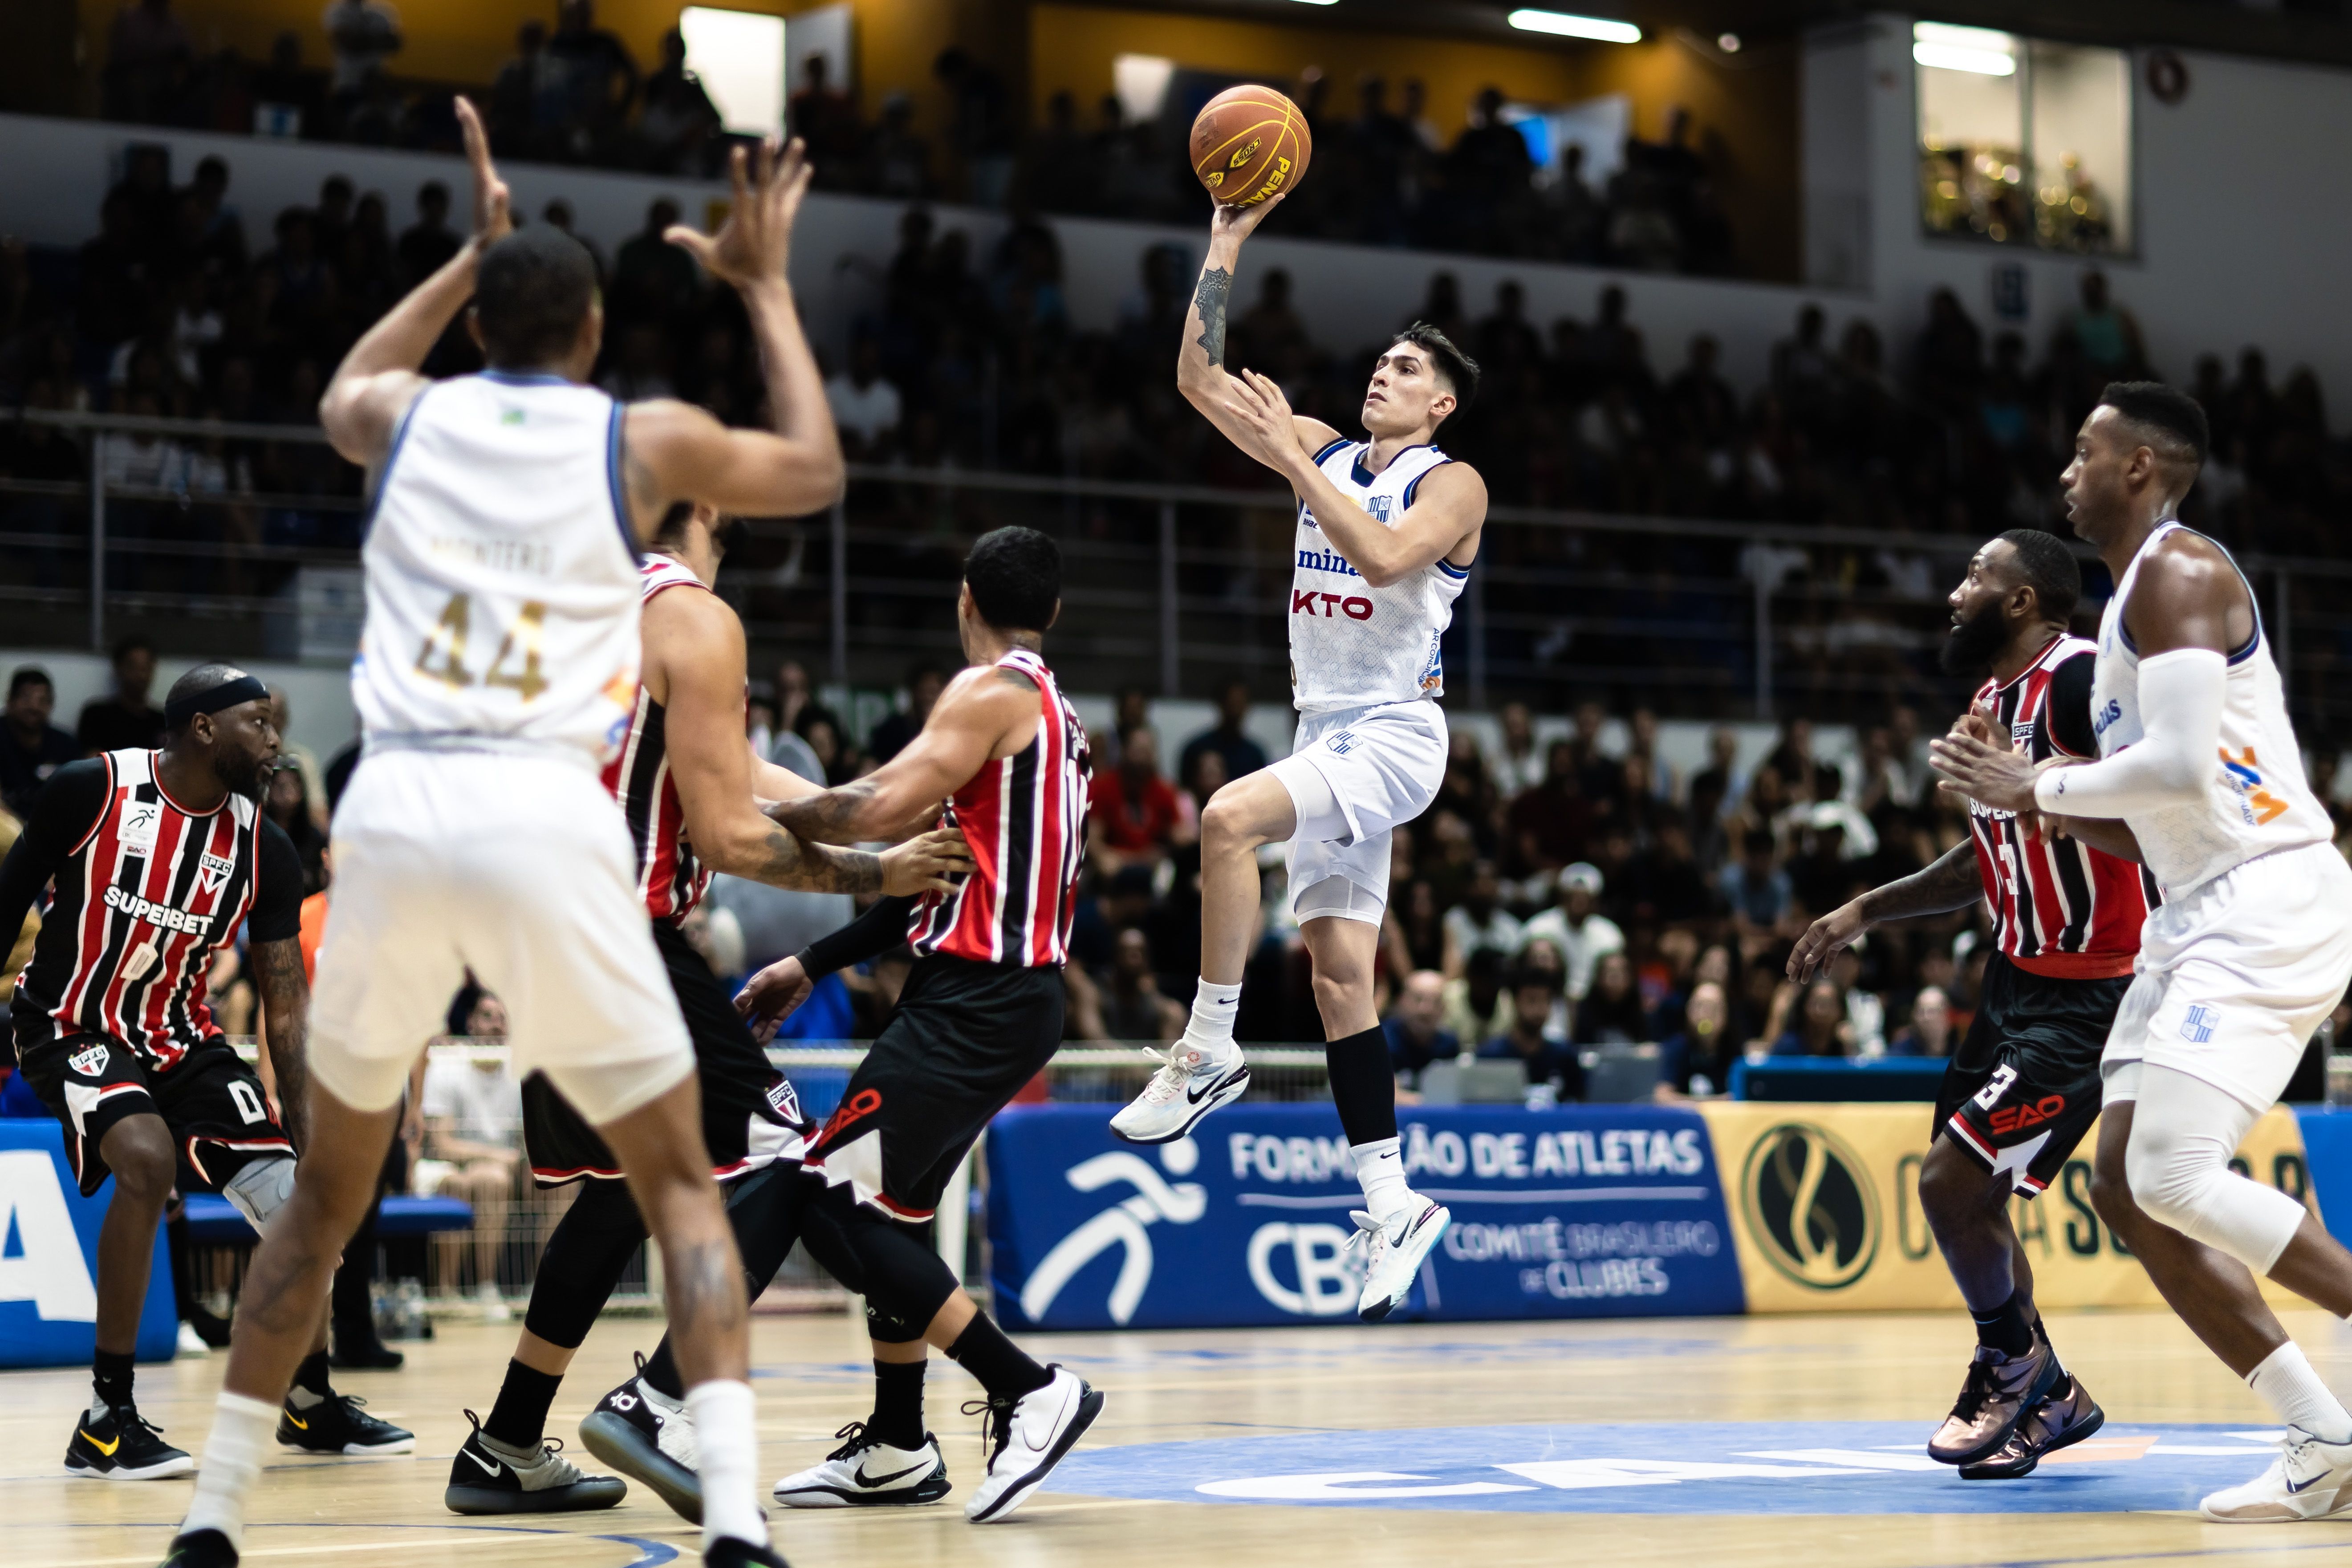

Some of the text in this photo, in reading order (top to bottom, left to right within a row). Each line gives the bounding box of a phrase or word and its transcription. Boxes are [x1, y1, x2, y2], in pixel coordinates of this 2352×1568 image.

[1233, 138, 1261, 166] CROSS
[1206, 173, 1222, 187] OVER
[1239, 156, 1291, 207] PENAL
[1292, 589, 1373, 621] KTO
[413, 592, 549, 704] 44
[202, 854, 232, 874] SPFC
[771, 1085, 792, 1105] SPFC
[1973, 1063, 2018, 1111] 3
[1469, 1131, 1529, 1179] DE
[1532, 1129, 1704, 1178] ATLETAS
[1247, 1221, 1398, 1317] CB
